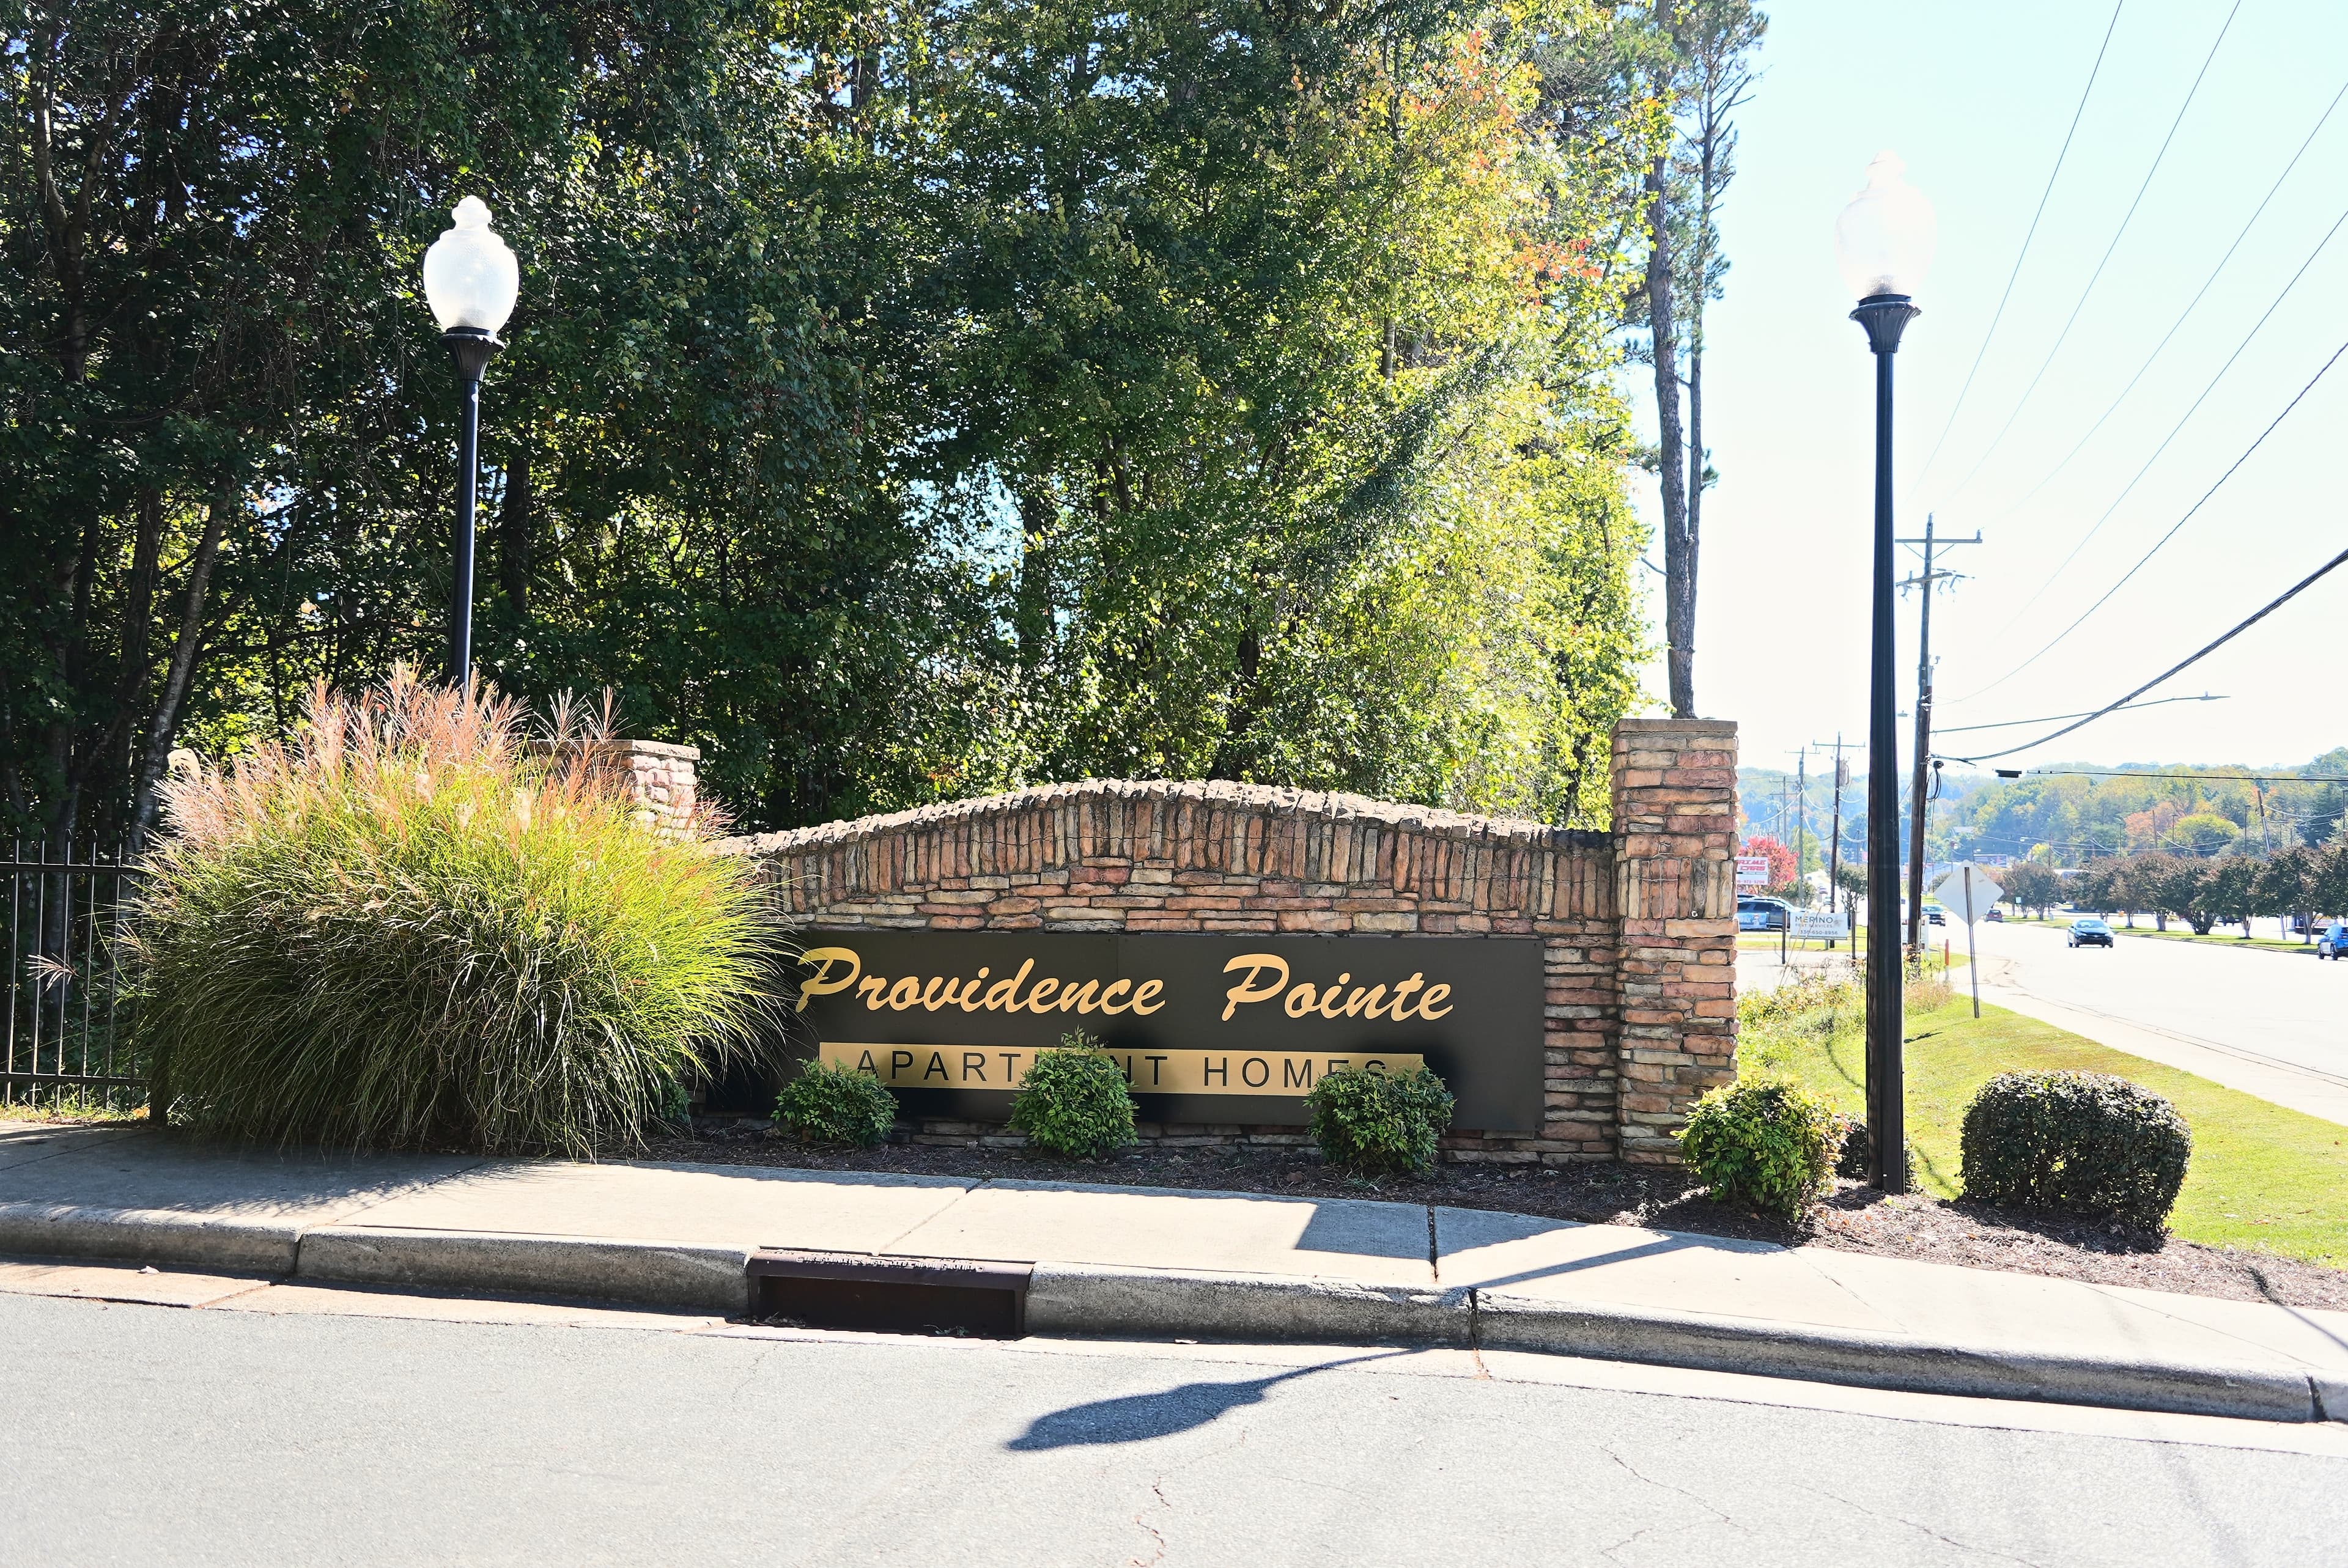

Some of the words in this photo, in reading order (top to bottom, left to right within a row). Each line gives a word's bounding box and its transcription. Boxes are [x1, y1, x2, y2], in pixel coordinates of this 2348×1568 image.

[797, 946, 1165, 1015] Providence
[1222, 953, 1453, 1021] Pointe
[857, 1050, 1168, 1086] APARTNT
